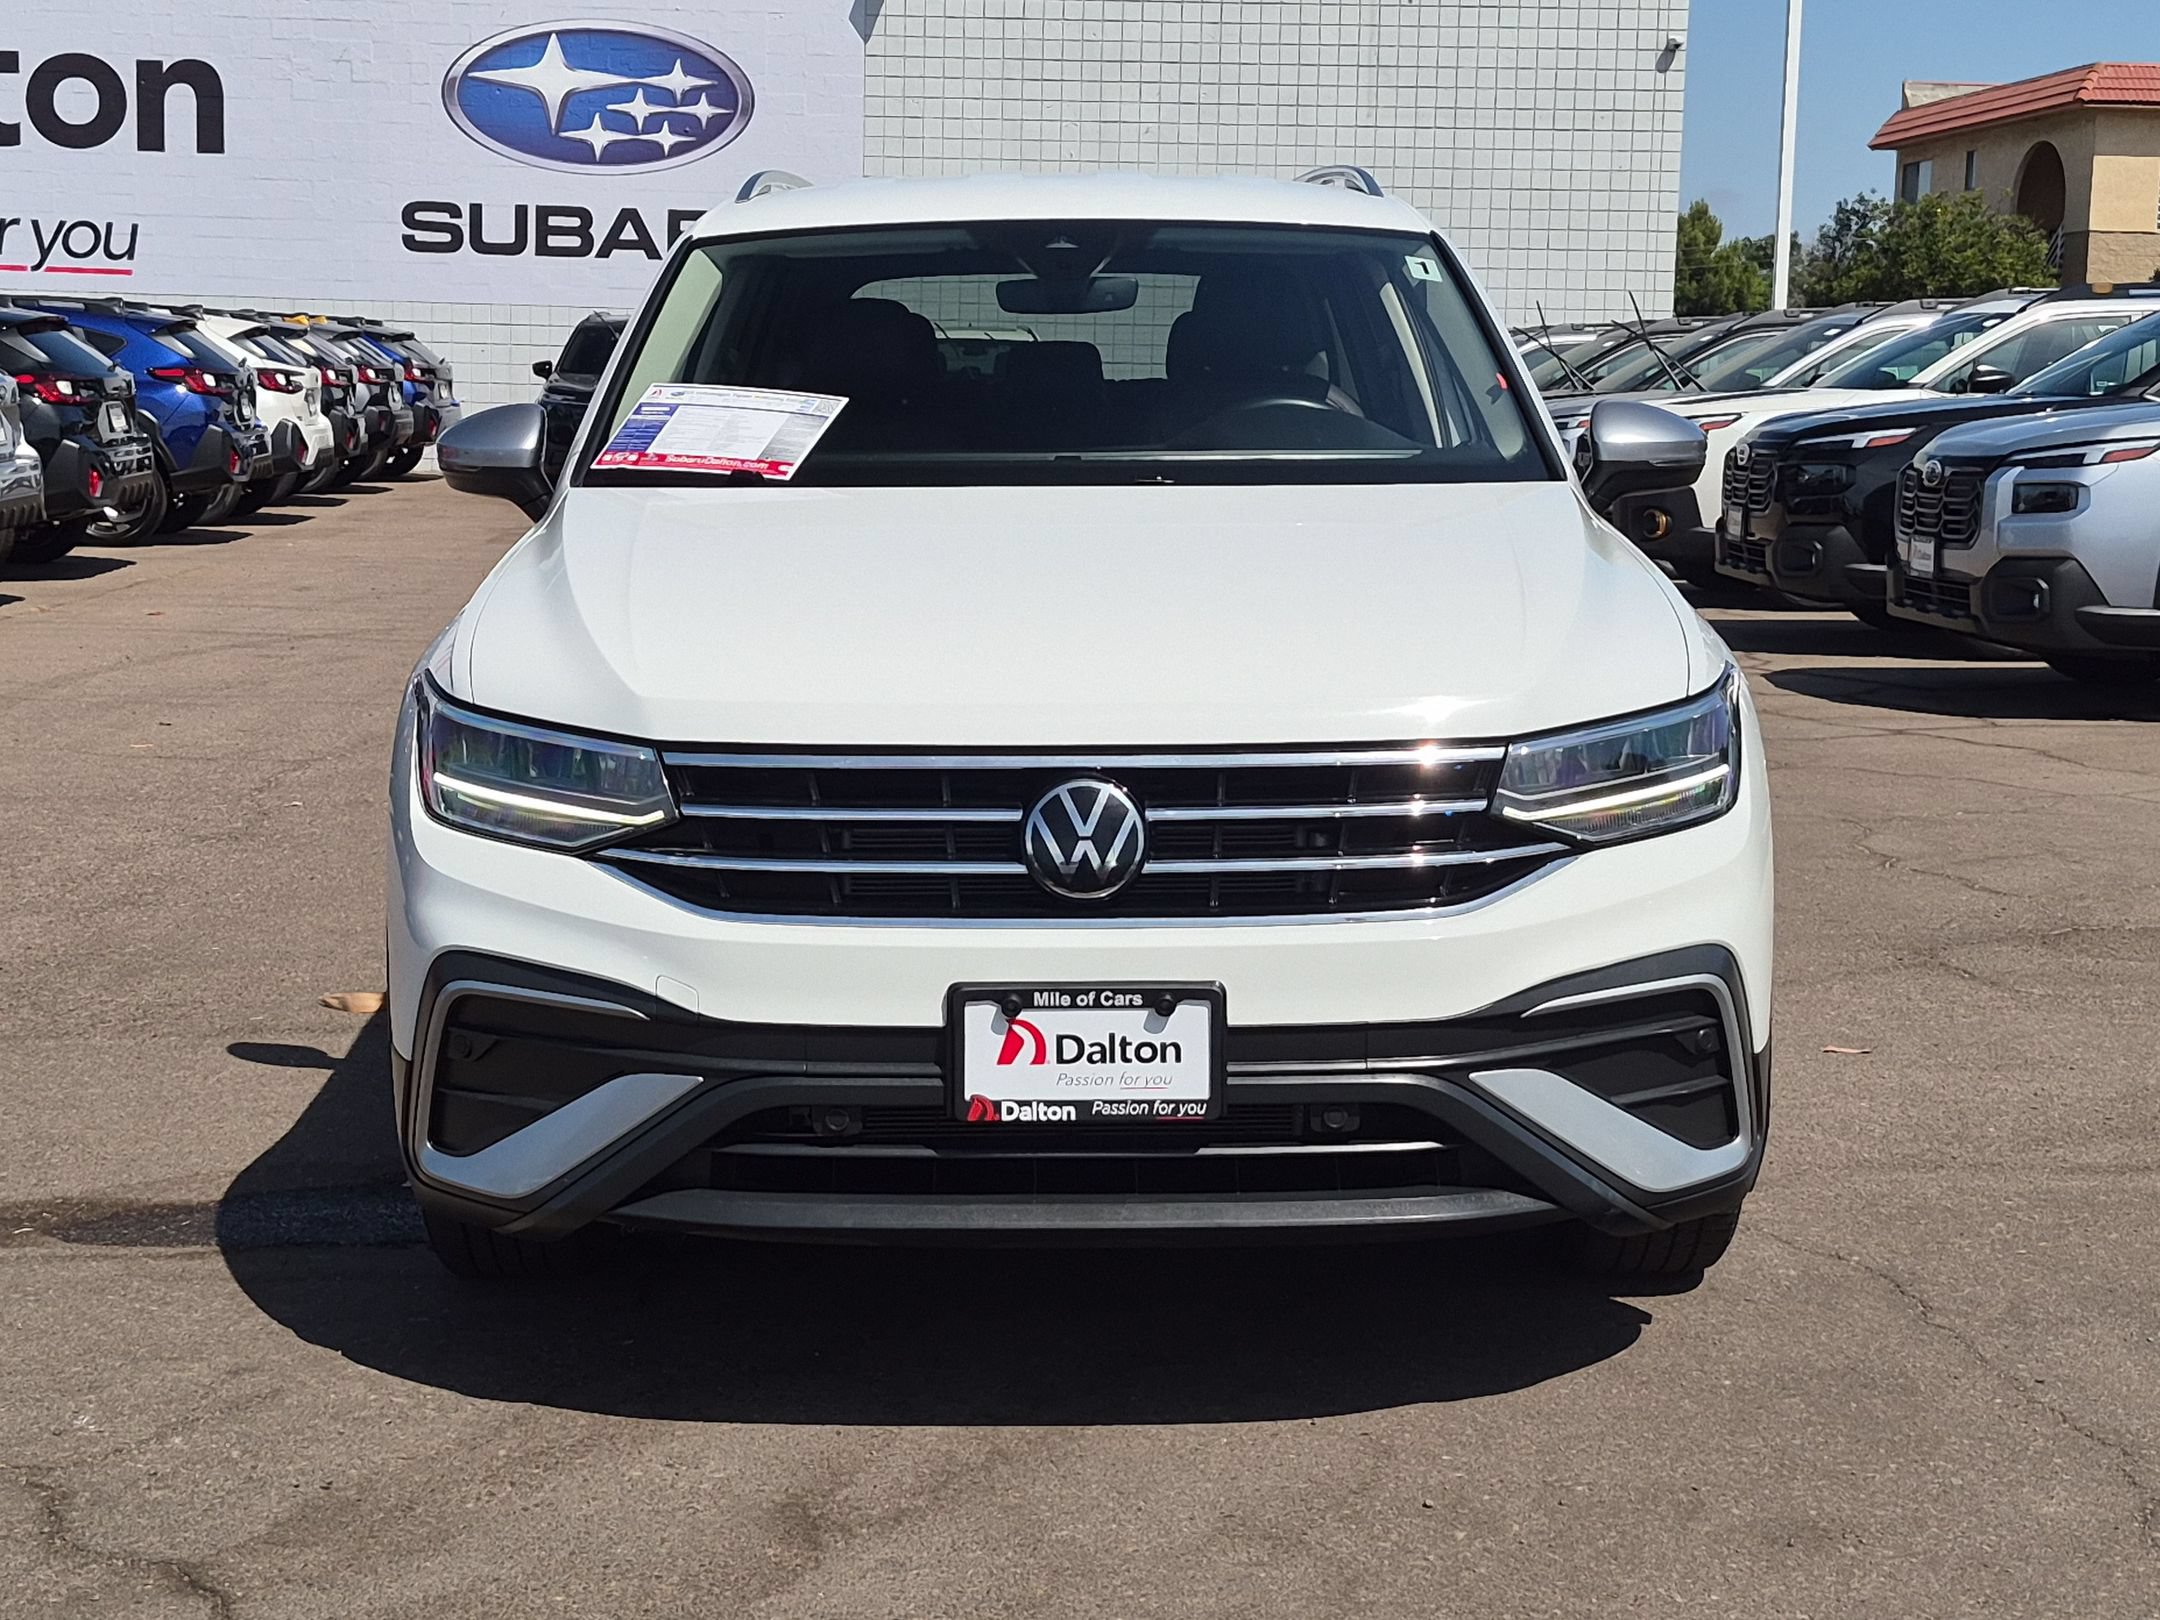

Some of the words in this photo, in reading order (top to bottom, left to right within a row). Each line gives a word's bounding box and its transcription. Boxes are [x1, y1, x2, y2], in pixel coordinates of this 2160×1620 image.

[30, 219, 139, 271] you
[1026, 780, 1144, 898] VW
[1033, 991, 1072, 1007] Mile
[1076, 991, 1097, 1007] of
[1100, 991, 1143, 1007] Cars
[1055, 1032, 1182, 1065] Dalton
[1056, 1073, 1114, 1087] Passion
[1118, 1071, 1142, 1087] for
[1144, 1074, 1173, 1088] you
[1000, 1100, 1076, 1122] Dalton
[1092, 1100, 1149, 1116] Passion
[1152, 1100, 1174, 1117] for
[1177, 1102, 1207, 1117] you
